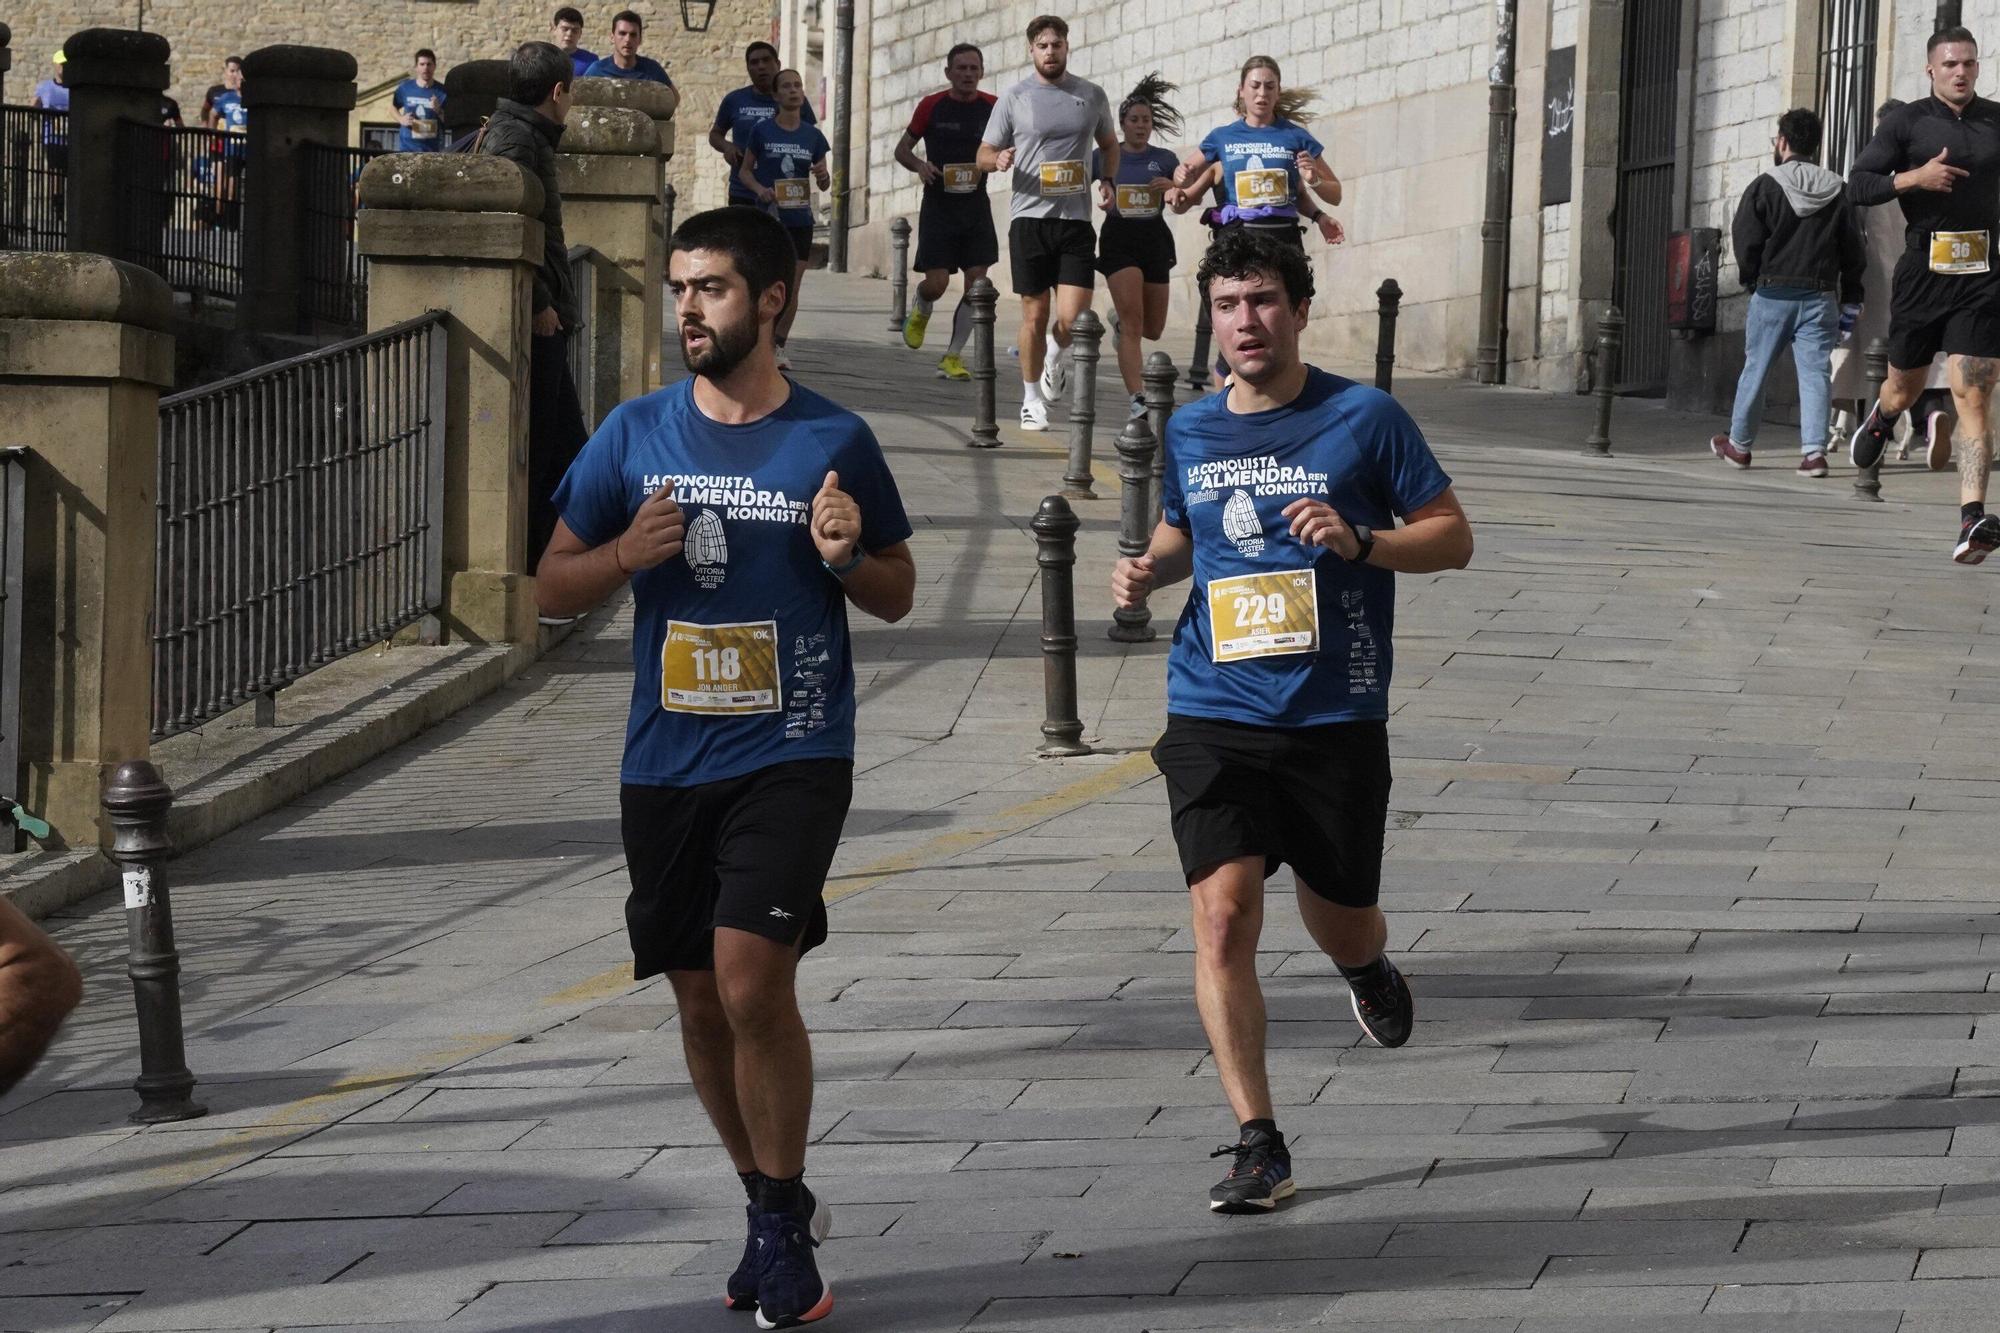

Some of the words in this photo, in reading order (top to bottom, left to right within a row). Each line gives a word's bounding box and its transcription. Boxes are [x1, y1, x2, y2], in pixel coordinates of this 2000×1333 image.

[1234, 147, 1286, 155] ALMENDRA
[1128, 192, 1150, 205] 443
[1952, 242, 1970, 258] 36
[1188, 466, 1199, 478] LA
[1200, 456, 1278, 475] CONQUISTA
[644, 475, 660, 486] LA
[661, 475, 754, 490] CONQUISTA
[1200, 466, 1307, 490] ALMENDRA
[1308, 473, 1328, 482] REN
[1255, 482, 1329, 497] KONKISTA
[789, 501, 808, 511] REN
[727, 508, 808, 525] KONKISTA
[1236, 538, 1264, 547] VITORIA
[696, 567, 725, 575] VITORIA
[1293, 577, 1307, 587] 10K
[1233, 593, 1286, 627] 229
[753, 631, 768, 640] 10K
[1252, 627, 1270, 636] ASIER
[692, 647, 741, 681] 118
